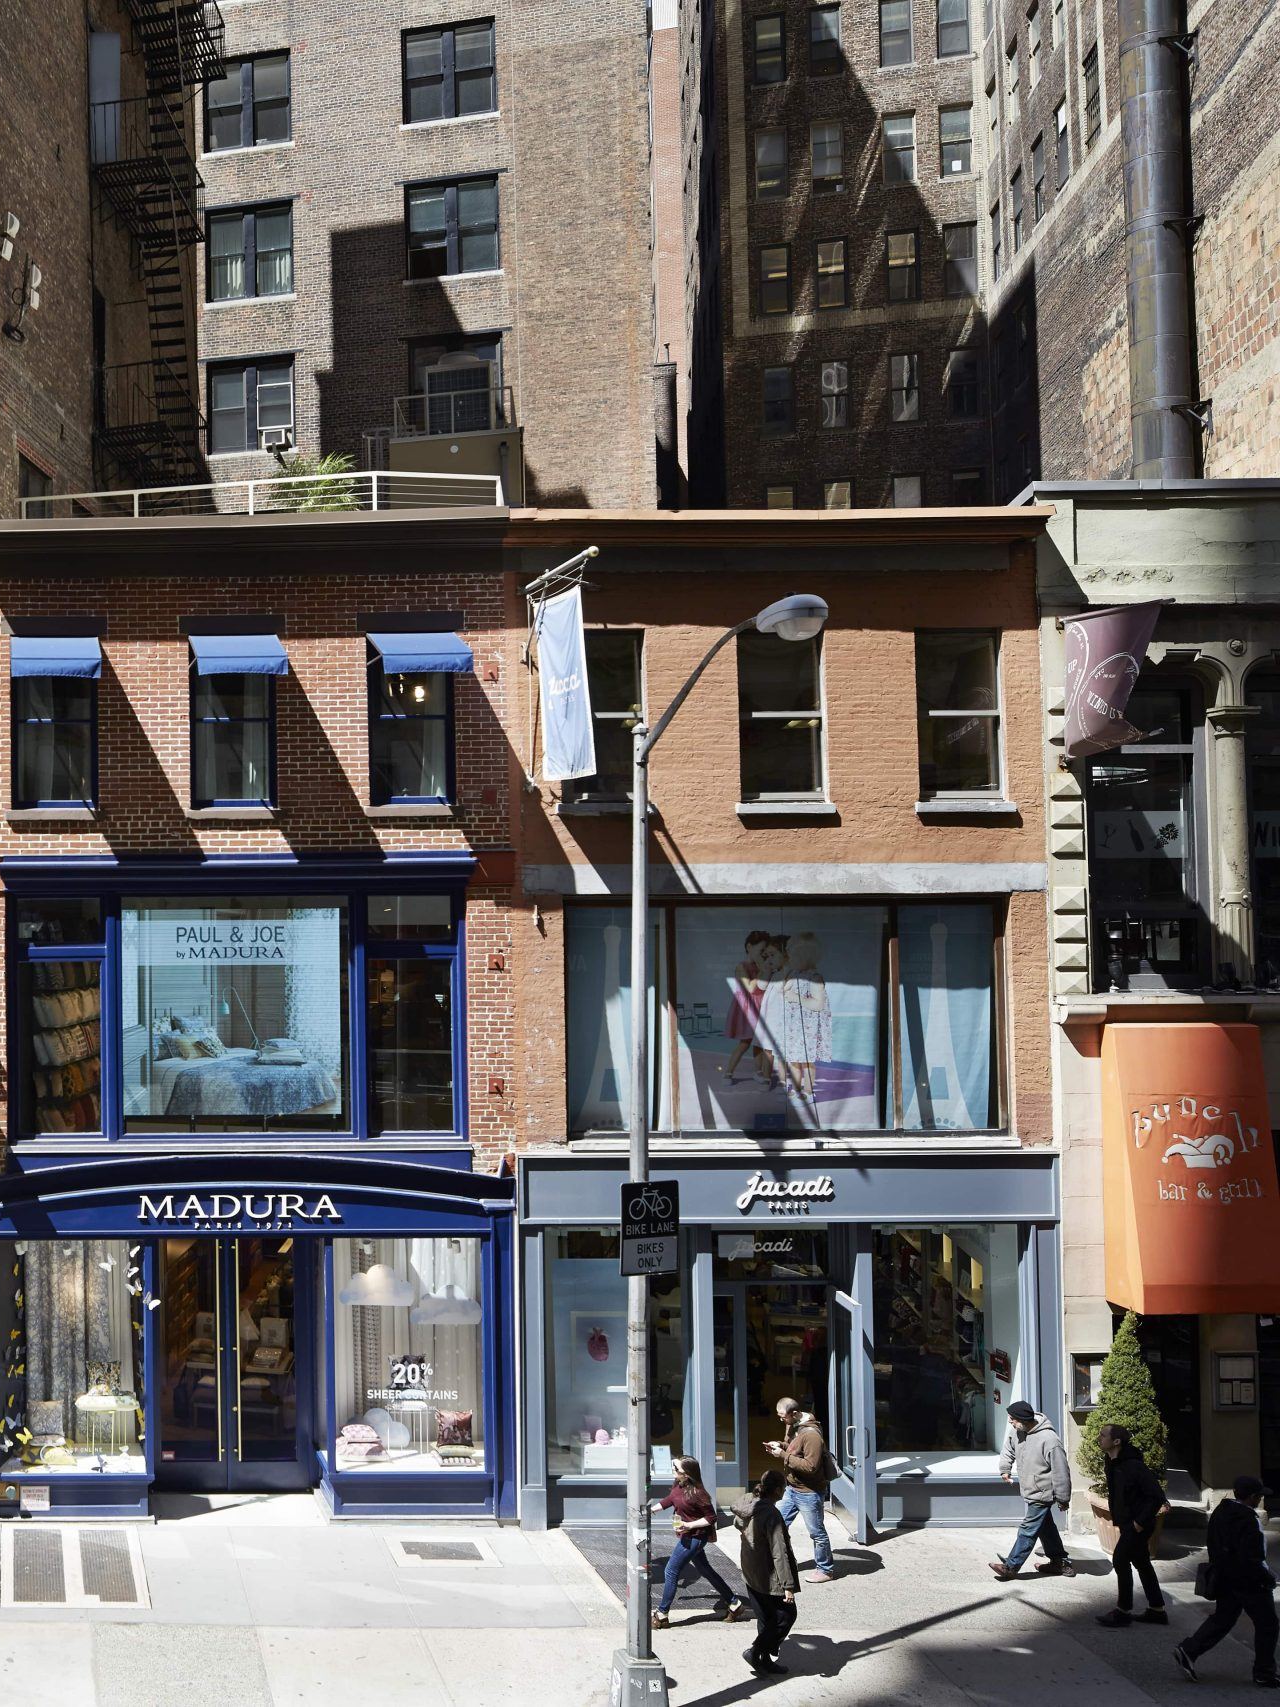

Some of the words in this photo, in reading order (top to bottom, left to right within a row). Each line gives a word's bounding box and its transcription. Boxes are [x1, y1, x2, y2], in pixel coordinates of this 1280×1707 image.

[176, 926, 223, 943] PAUL
[229, 926, 244, 943] &
[250, 926, 286, 943] JOE
[176, 950, 186, 959] by
[188, 946, 285, 959] MADURA
[1131, 1096, 1259, 1153] punch
[1157, 1180, 1189, 1201] bar
[1197, 1182, 1213, 1200] &
[1219, 1178, 1262, 1205] grill
[137, 1194, 342, 1219] MADURA
[768, 1201, 809, 1209] PARIS
[256, 1222, 293, 1230] 1971
[625, 1223, 647, 1236] BIKE
[650, 1221, 676, 1235] LANE
[637, 1241, 665, 1255] BIKES
[637, 1255, 664, 1270] ONLY
[394, 1363, 433, 1384] 20%
[367, 1390, 401, 1399] SHEER
